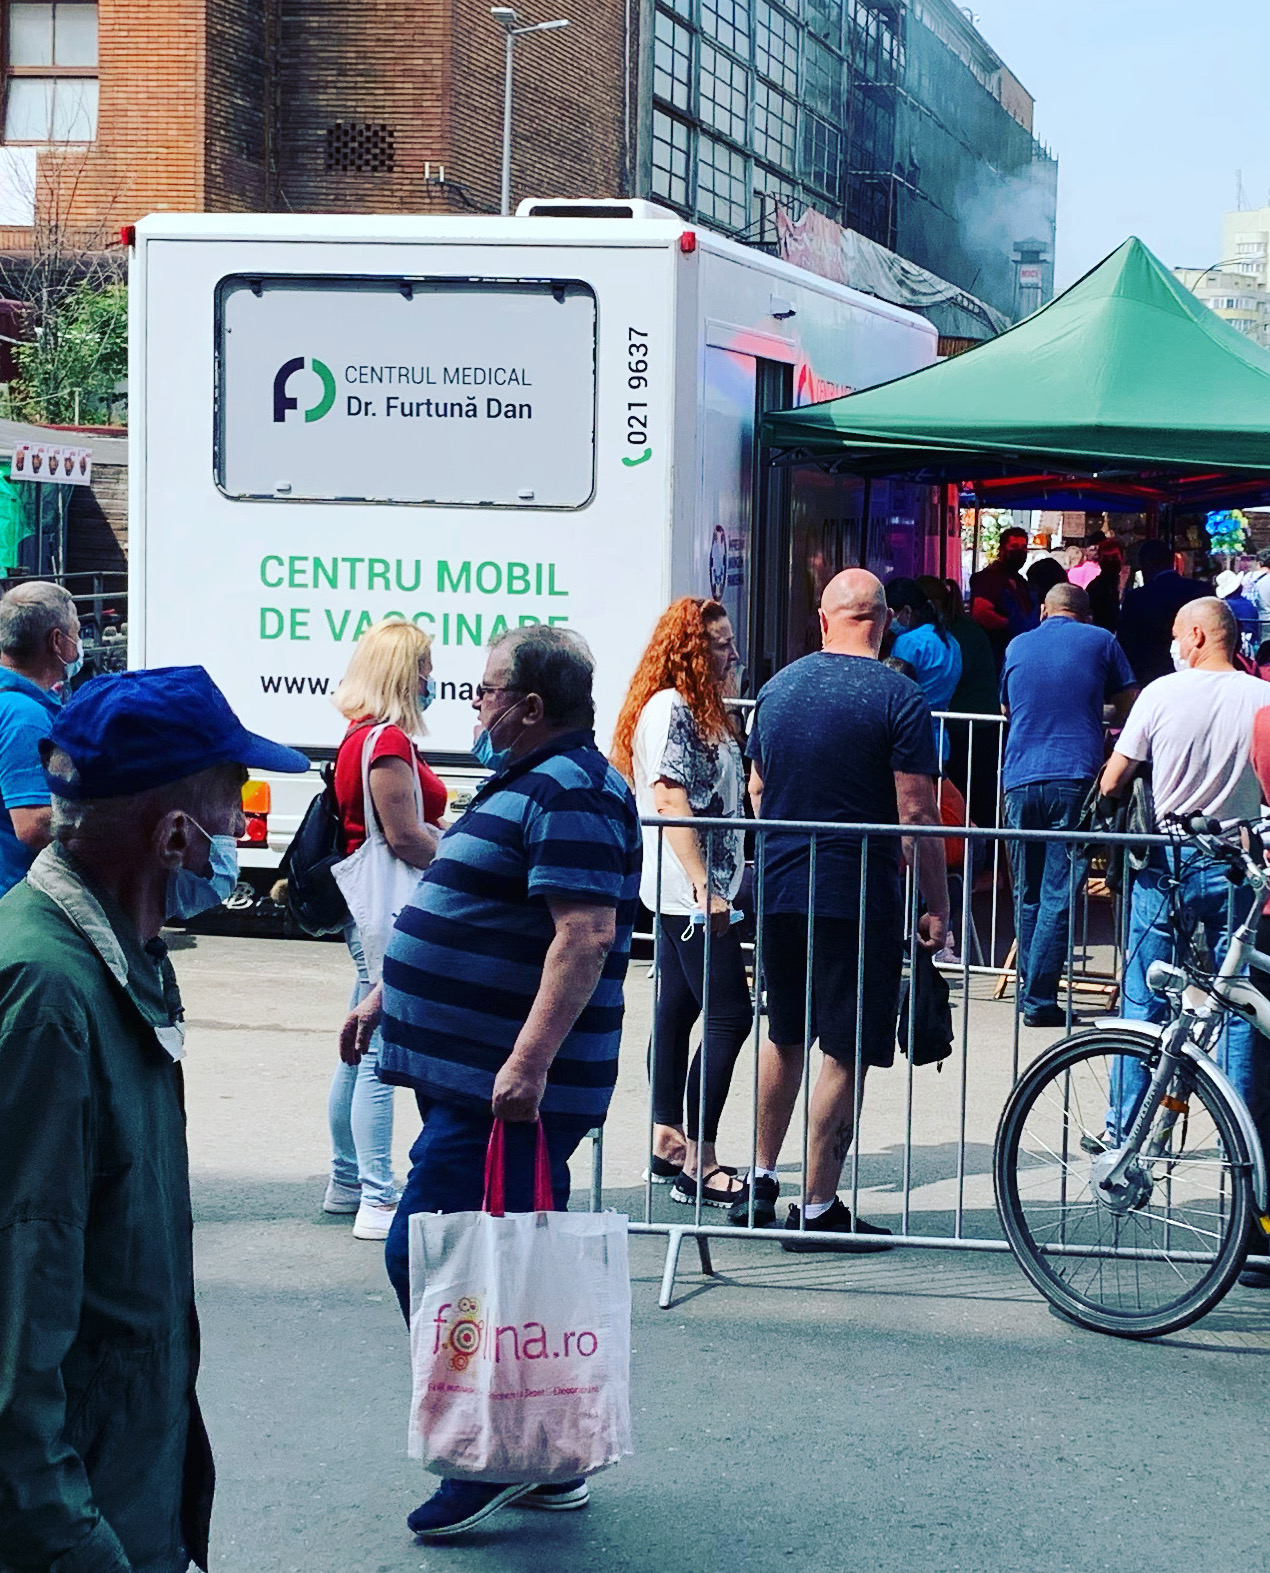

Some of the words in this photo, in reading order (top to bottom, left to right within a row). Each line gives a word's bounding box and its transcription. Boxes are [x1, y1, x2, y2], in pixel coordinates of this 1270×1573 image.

[345, 365, 436, 385] CENTRUL
[443, 367, 532, 387] MEDICAL
[627, 327, 649, 390] 9637
[346, 395, 377, 418] Dr.
[386, 395, 478, 419] Furtună
[486, 398, 532, 420] Dan
[627, 401, 649, 445] 021
[260, 555, 422, 592] CENTRU
[436, 560, 570, 597] MOBIL
[260, 607, 311, 641] DE
